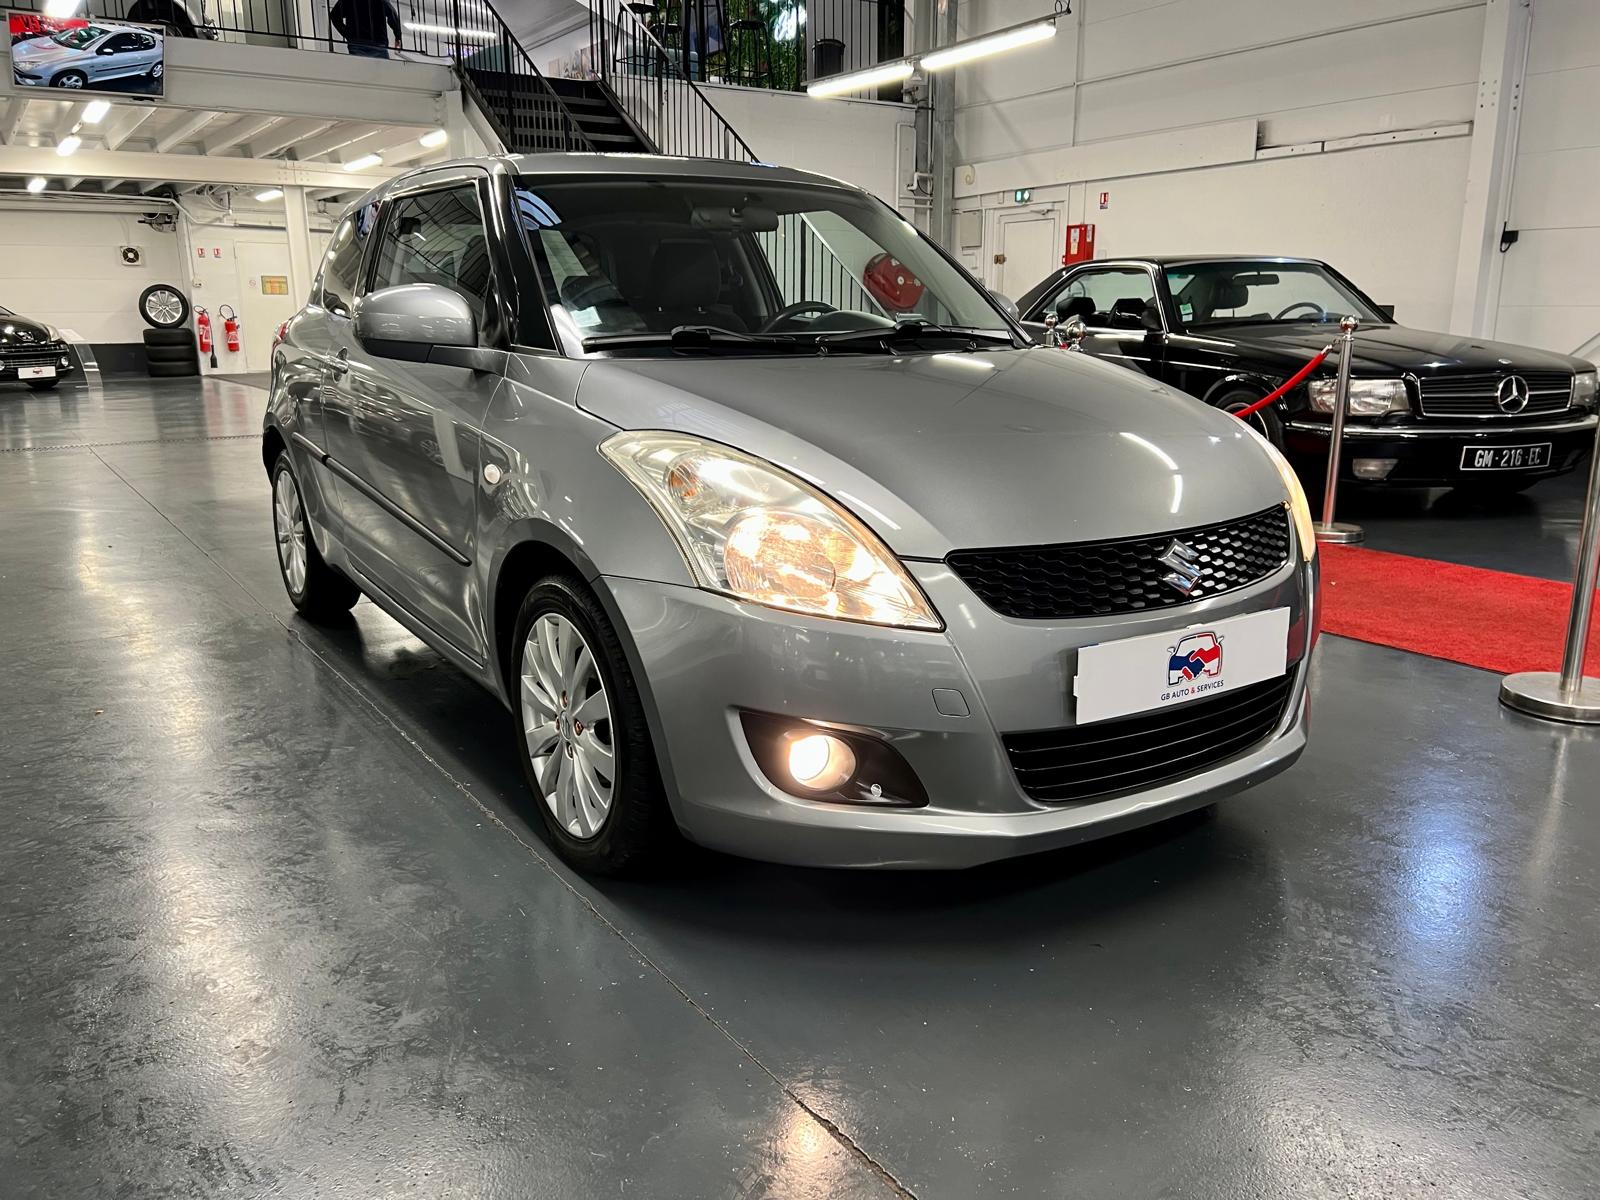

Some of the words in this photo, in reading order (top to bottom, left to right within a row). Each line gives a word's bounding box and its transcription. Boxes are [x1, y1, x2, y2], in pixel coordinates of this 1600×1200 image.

[1160, 693, 1170, 701] GB
[1171, 688, 1190, 698] AUTO
[1196, 680, 1224, 692] SERVICES
